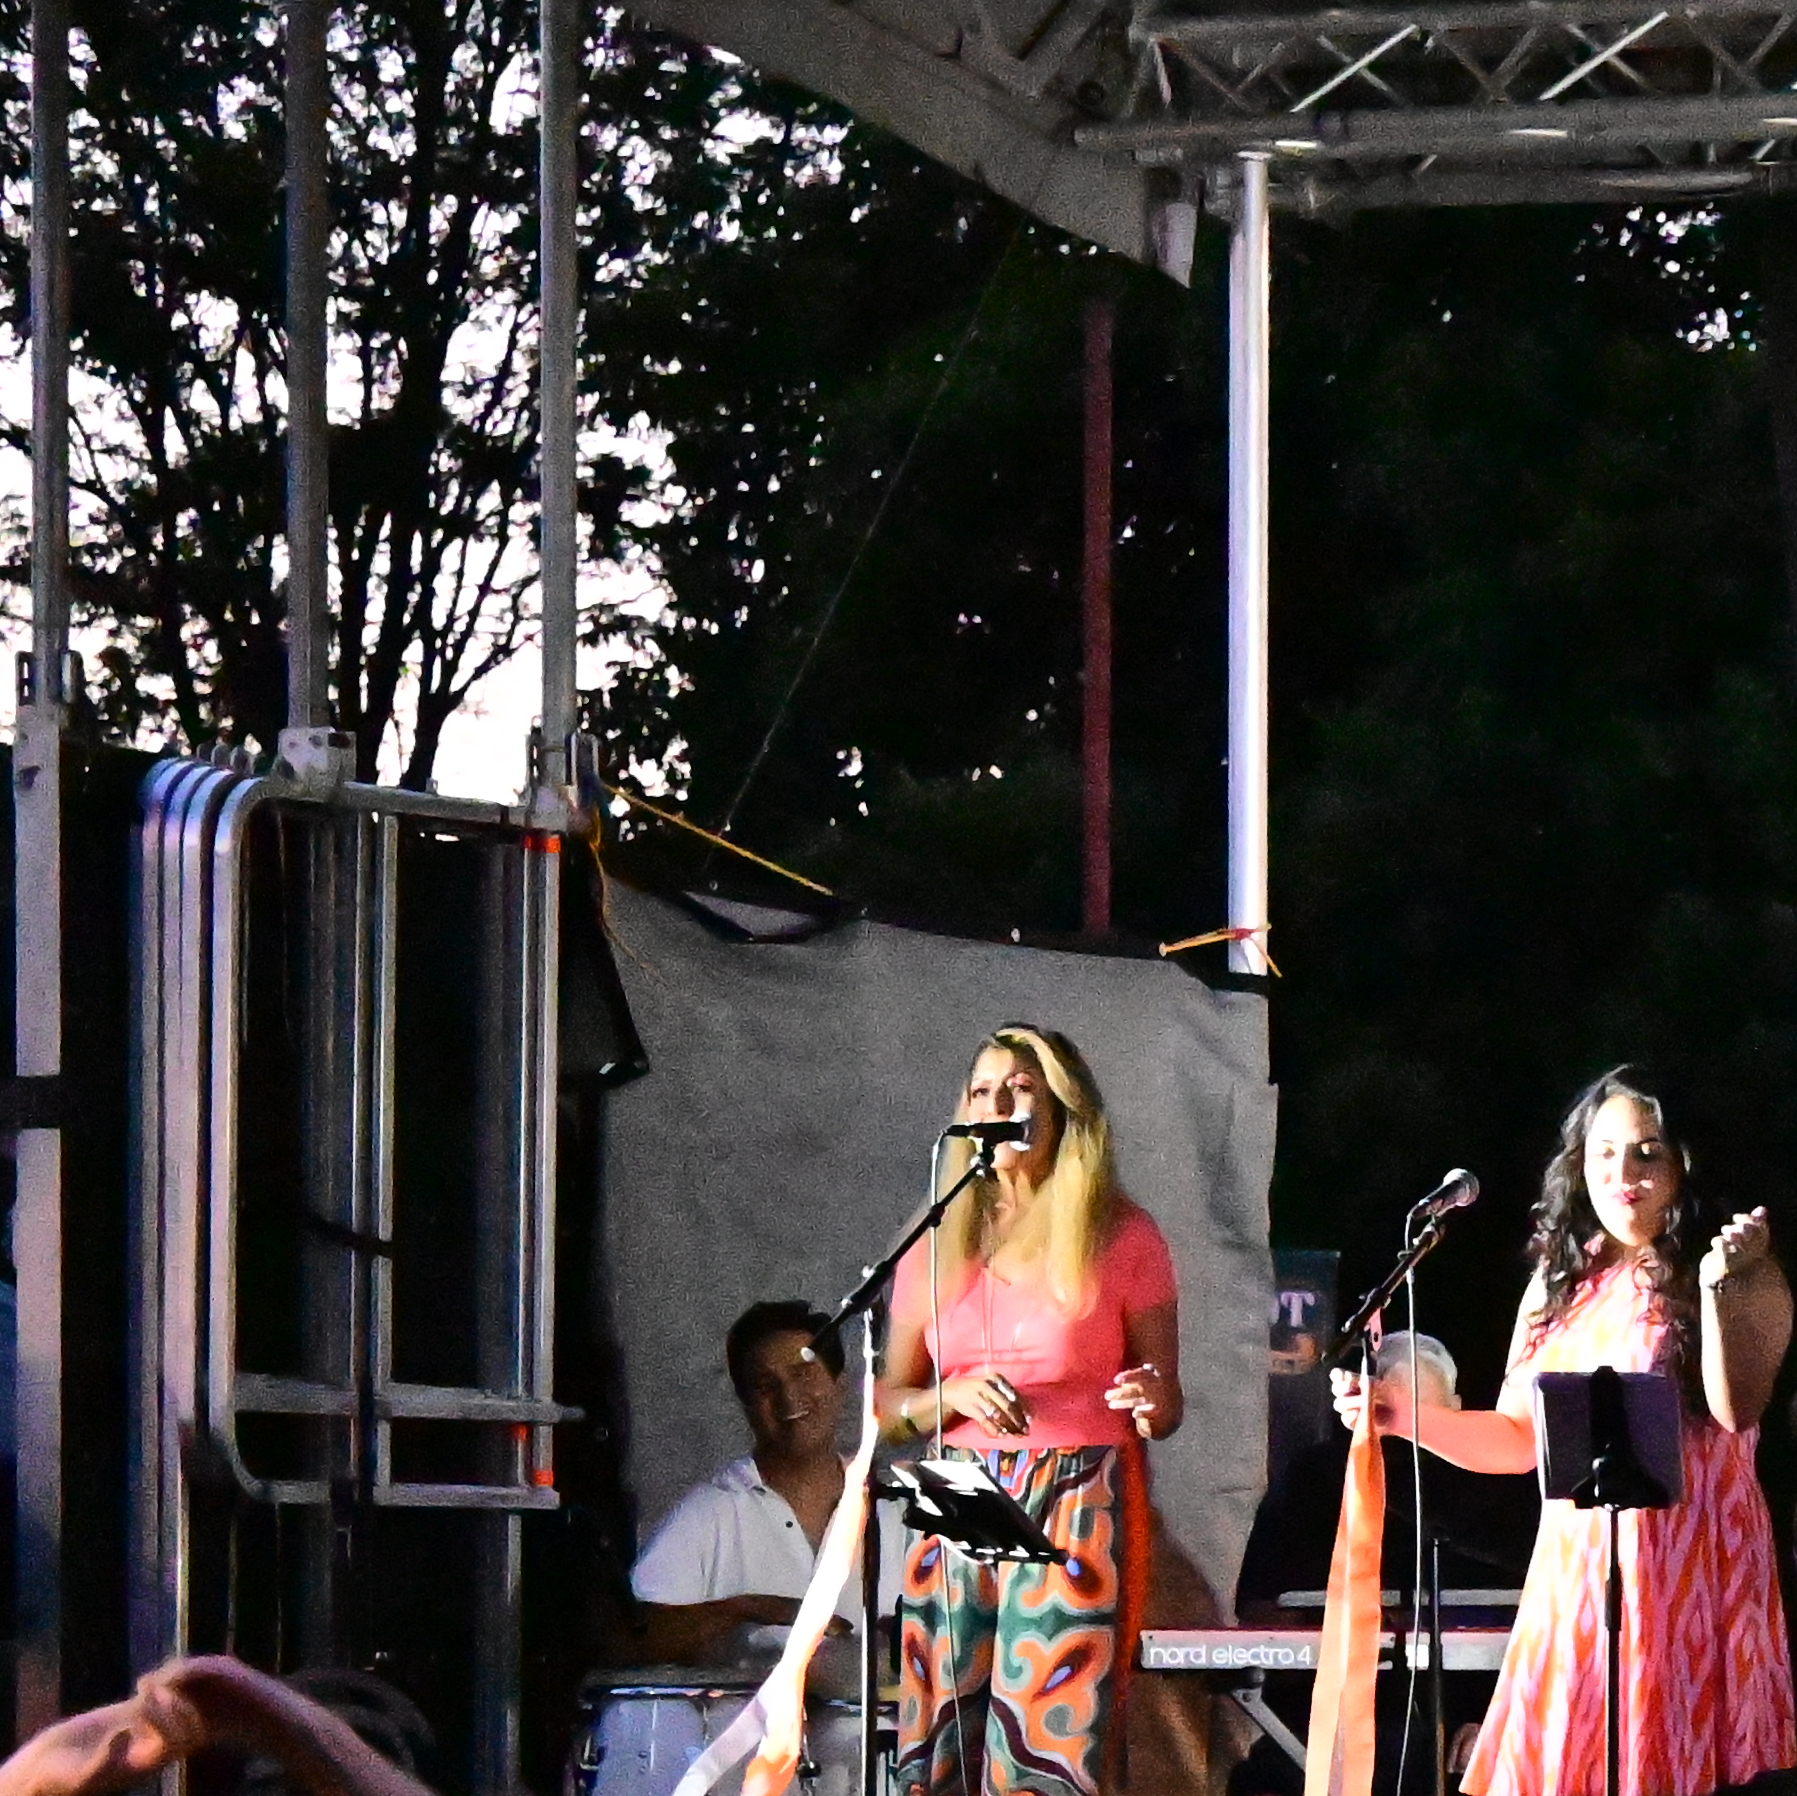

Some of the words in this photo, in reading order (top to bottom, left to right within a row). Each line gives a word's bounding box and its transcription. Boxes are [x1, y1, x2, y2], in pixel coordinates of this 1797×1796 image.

[1149, 1644, 1207, 1665] nord
[1211, 1644, 1295, 1665] electro
[1299, 1645, 1312, 1665] 4
